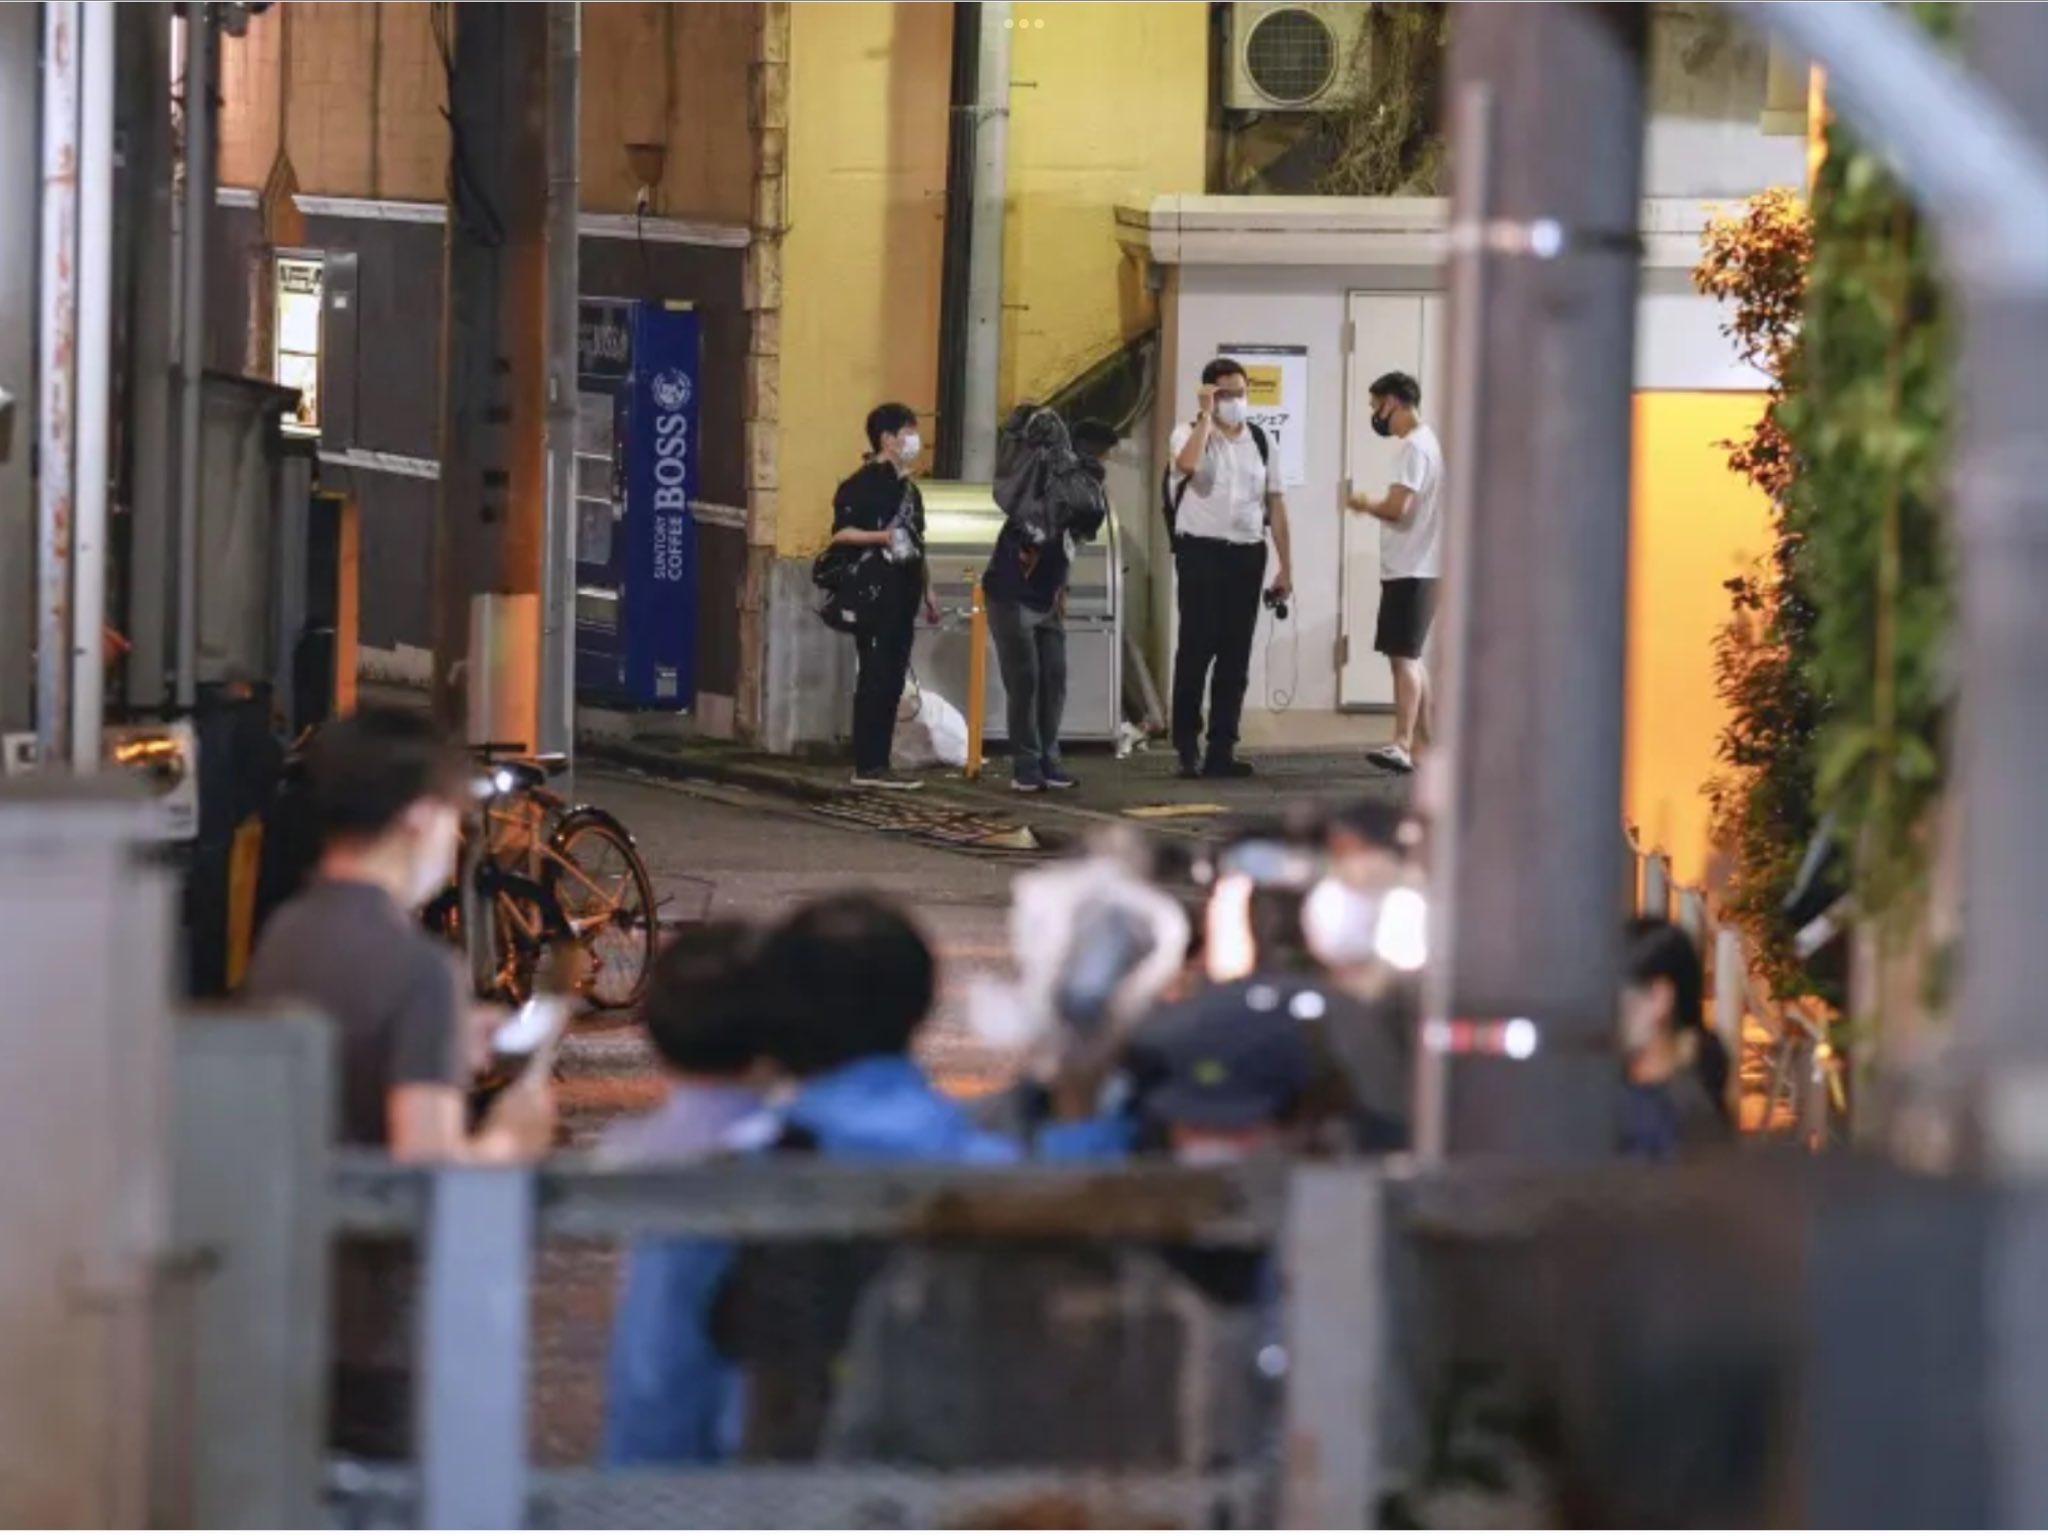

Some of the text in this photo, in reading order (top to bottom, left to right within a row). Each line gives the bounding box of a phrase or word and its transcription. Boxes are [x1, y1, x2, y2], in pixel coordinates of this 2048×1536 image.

[654, 413, 688, 511] BOSS
[654, 516, 667, 579] SUNTORY
[668, 514, 683, 581] COFFEE
